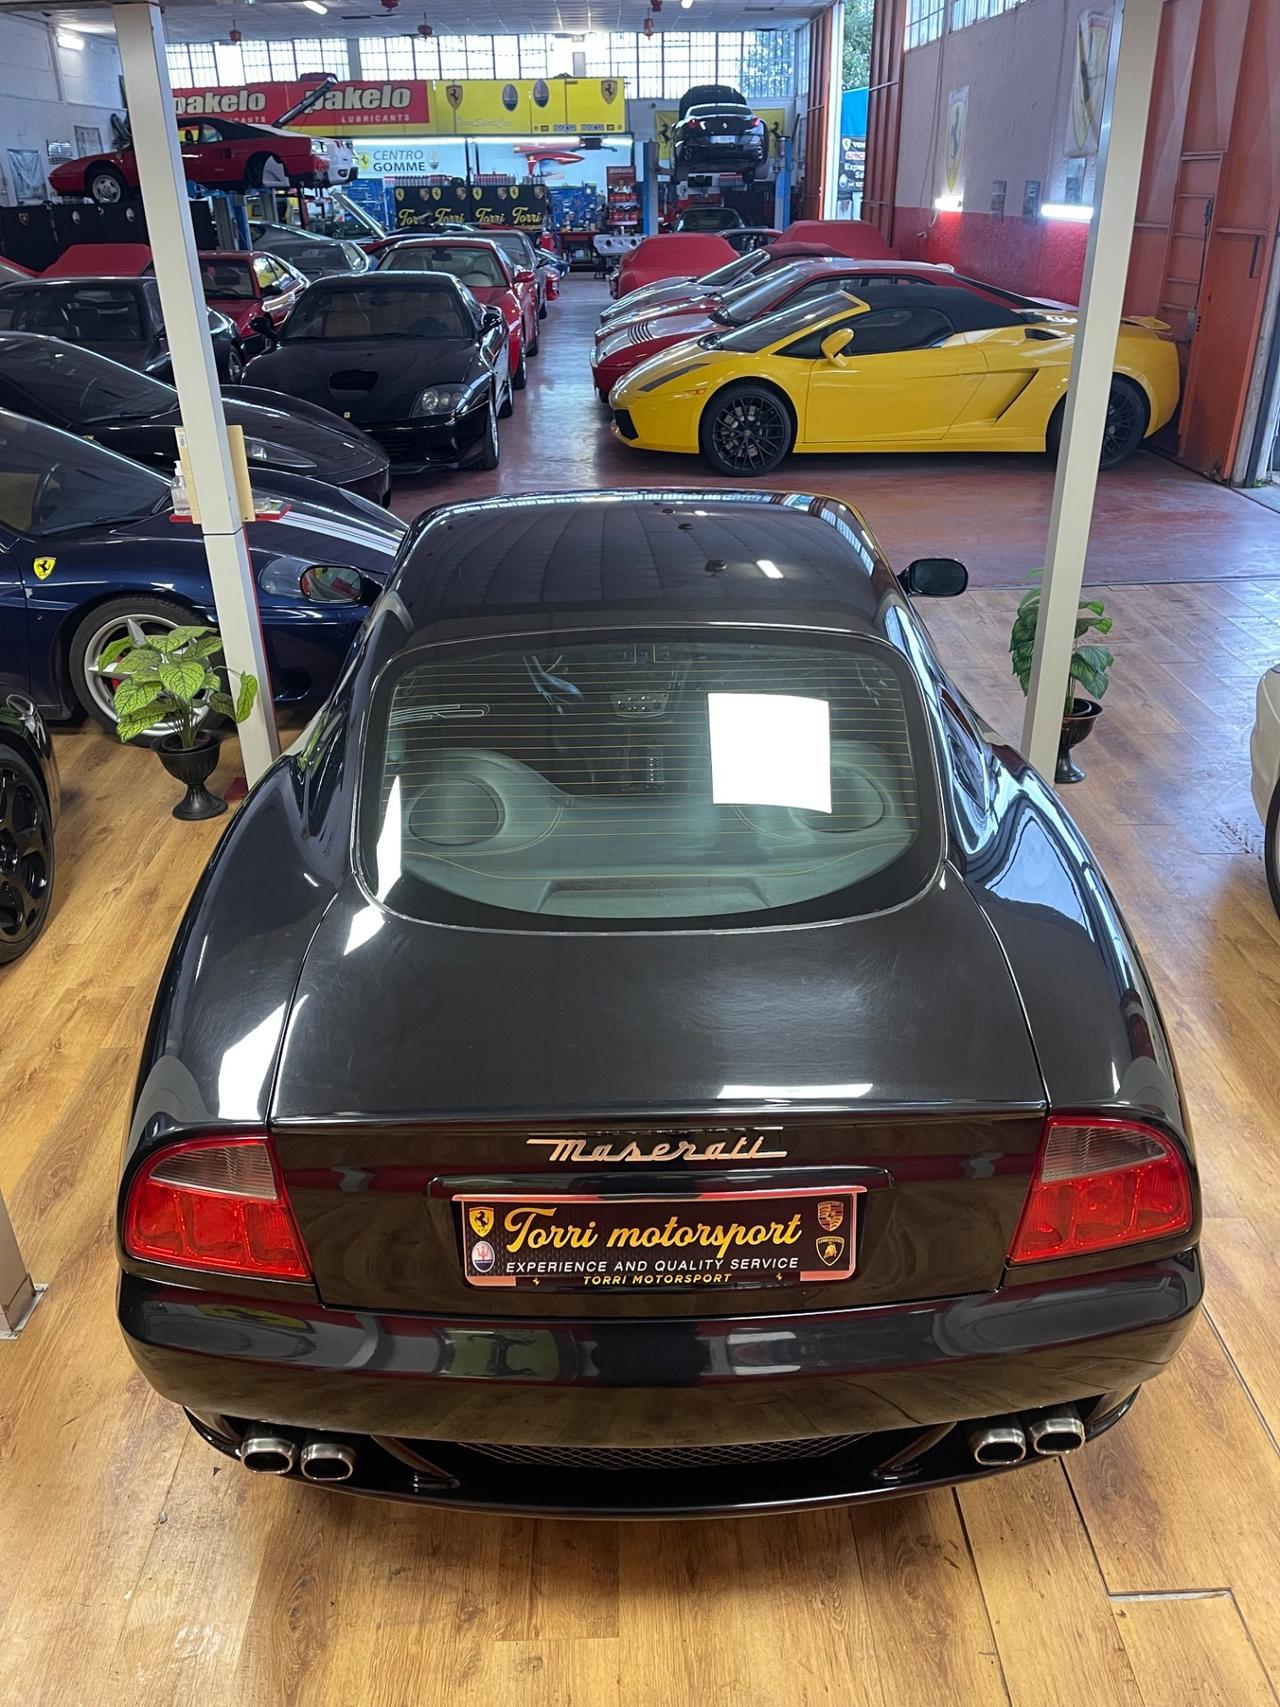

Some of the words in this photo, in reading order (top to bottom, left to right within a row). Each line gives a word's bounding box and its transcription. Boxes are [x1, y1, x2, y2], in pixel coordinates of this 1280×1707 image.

[341, 114, 410, 123] LUBRICANTS
[373, 150, 424, 161] CENTRO
[373, 162, 426, 172] GOMME
[398, 208, 421, 226] Tor
[434, 207, 465, 225] Torri
[475, 207, 506, 225] Torri
[511, 206, 543, 225] Torri
[526, 1136, 788, 1162] Maserati
[504, 1207, 599, 1253] Torri
[606, 1214, 803, 1259] motorsport
[506, 1261, 608, 1273] EXPERIENCE
[614, 1260, 648, 1272] AND
[654, 1259, 724, 1272] QUALITY
[730, 1257, 799, 1270] SERVICE
[583, 1275, 627, 1285] TORRI
[632, 1273, 732, 1285] MOTORSPORT
